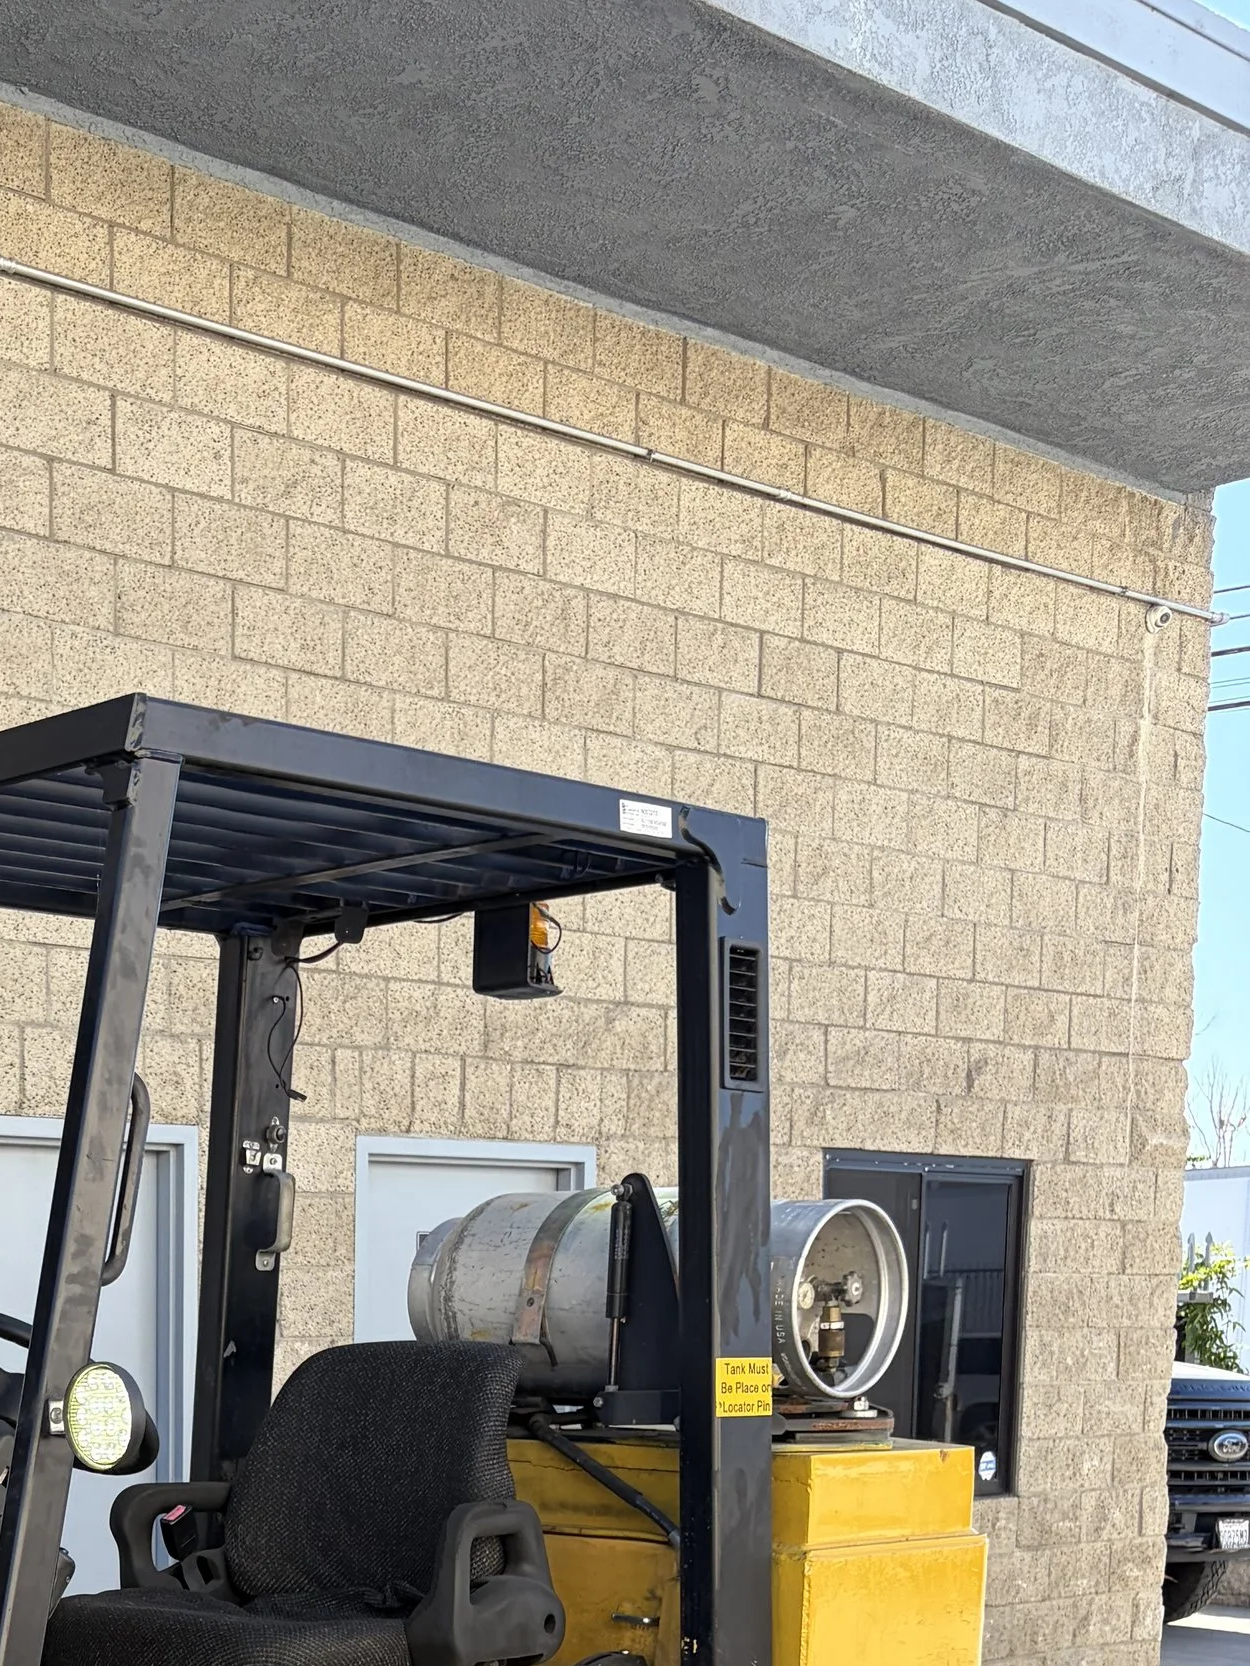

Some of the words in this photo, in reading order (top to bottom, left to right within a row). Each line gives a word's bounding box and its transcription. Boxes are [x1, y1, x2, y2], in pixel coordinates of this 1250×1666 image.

[775, 1324, 786, 1344] USA
[724, 1363, 746, 1375] Tank
[748, 1363, 769, 1375] Must
[721, 1382, 733, 1394] Be
[735, 1382, 759, 1394] Place
[757, 1400, 770, 1412] Pin
